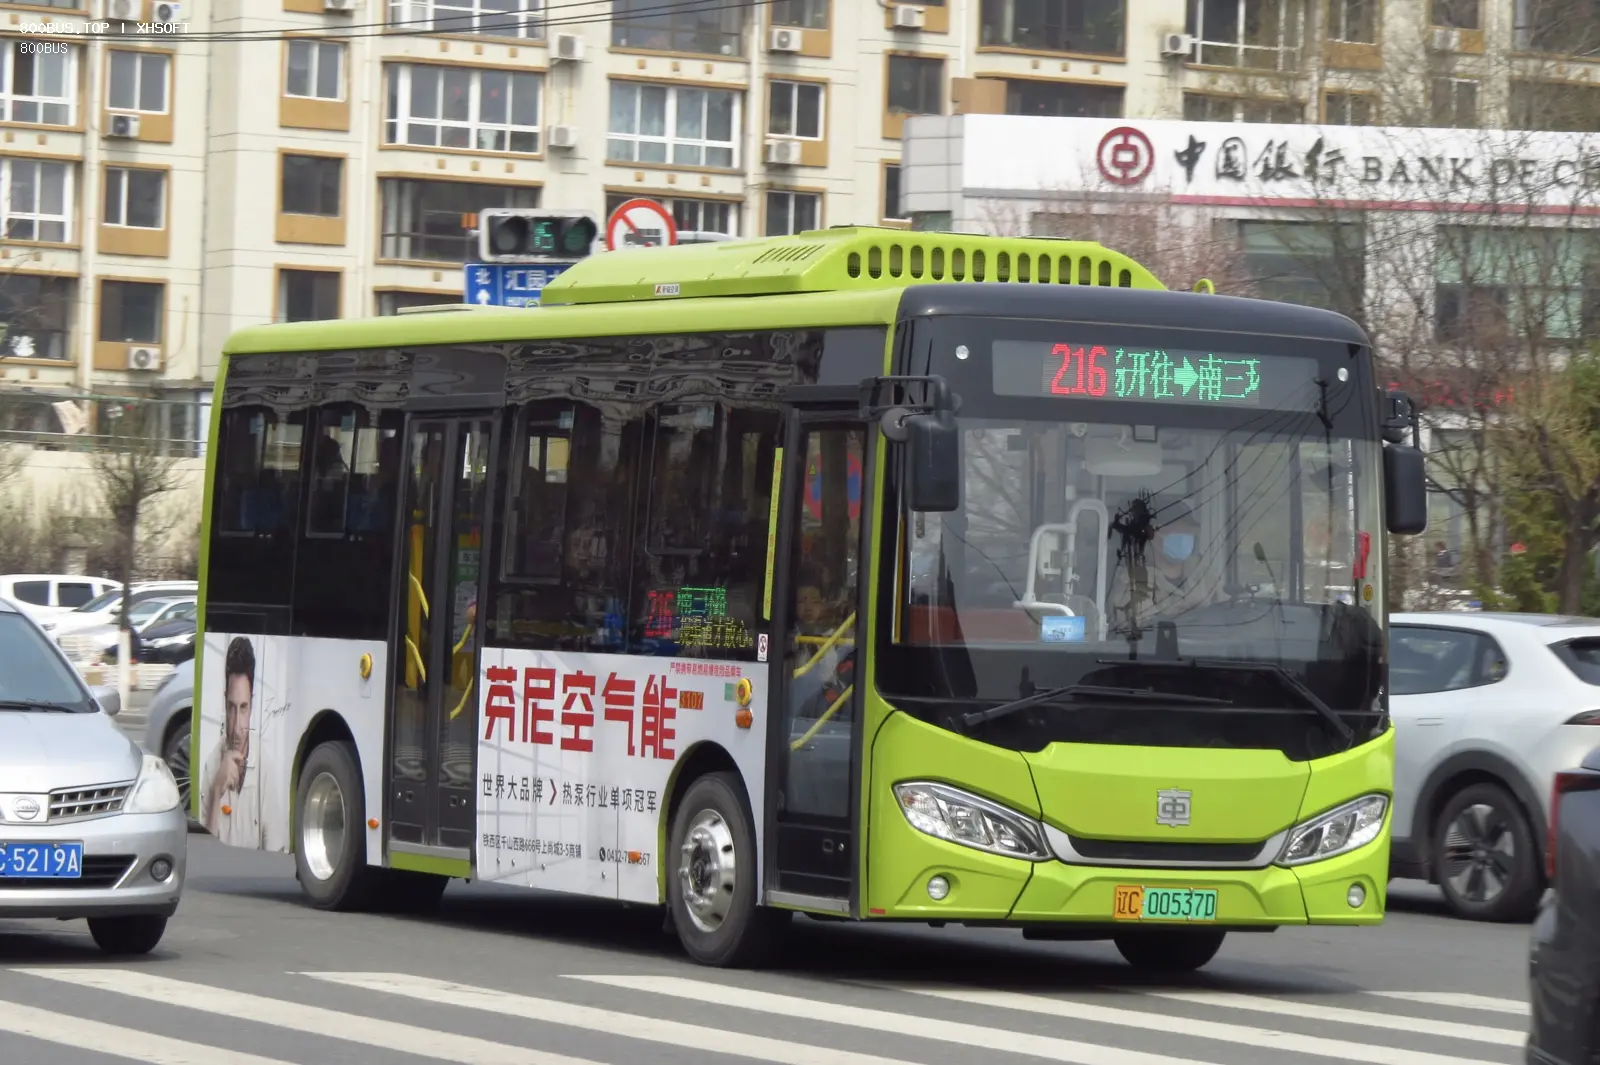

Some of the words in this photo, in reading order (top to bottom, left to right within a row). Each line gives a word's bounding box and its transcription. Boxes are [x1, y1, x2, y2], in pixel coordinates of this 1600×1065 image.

[1174, 134, 1345, 184] 中国银行
[1362, 156, 1477, 187] BANK
[475, 268, 491, 285] 北
[1051, 343, 1107, 396] 216
[485, 665, 678, 760] 芬尼空气能
[483, 773, 543, 803] 世界大品牌
[562, 782, 657, 814] 热泵行业单项冠军
